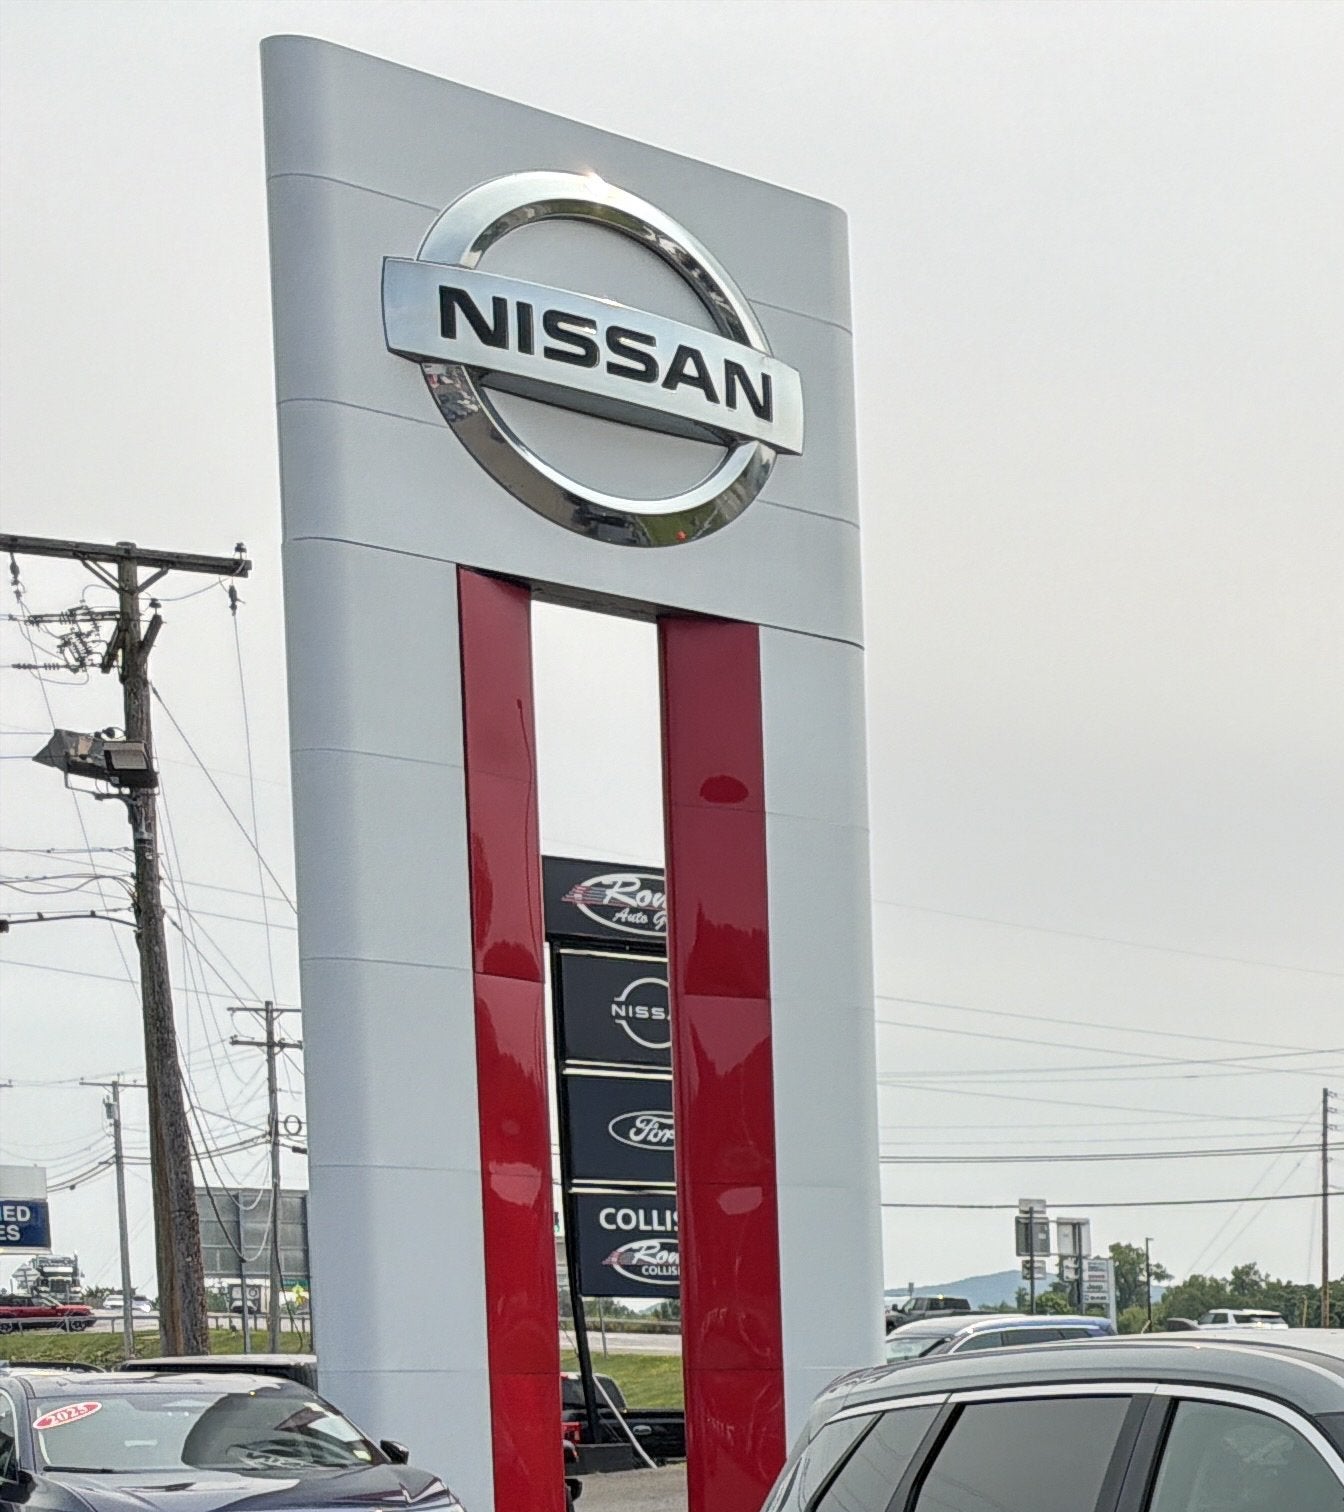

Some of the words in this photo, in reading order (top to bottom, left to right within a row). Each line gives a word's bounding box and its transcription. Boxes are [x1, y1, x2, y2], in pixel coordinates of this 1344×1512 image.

[437, 284, 774, 423] NISSAN
[612, 907, 648, 923] Auto
[611, 1003, 671, 1021] NISS
[0, 1205, 31, 1222] ED
